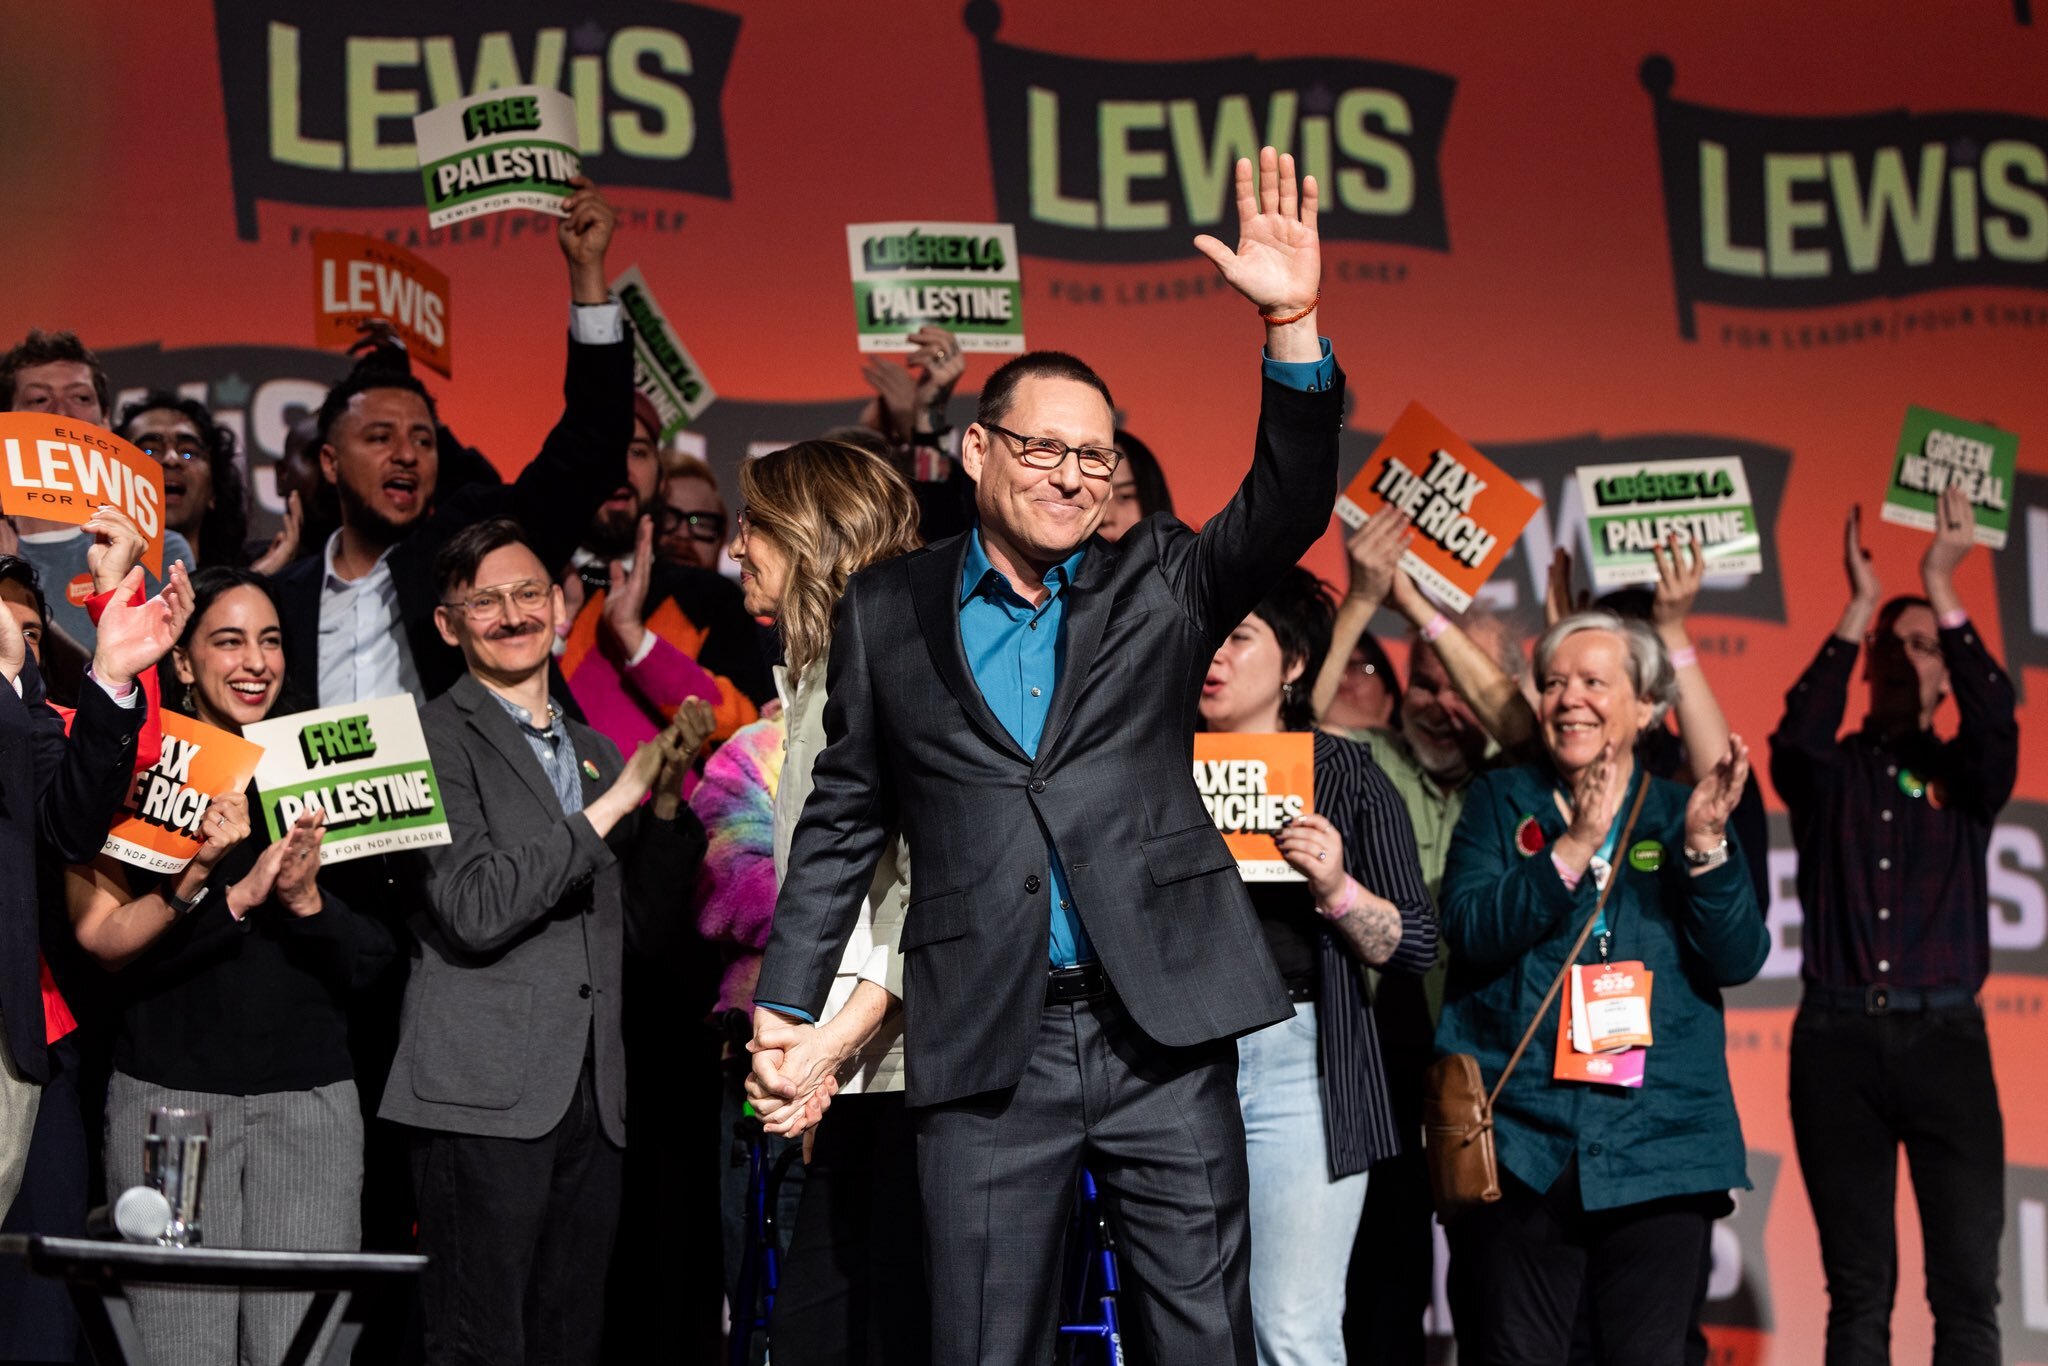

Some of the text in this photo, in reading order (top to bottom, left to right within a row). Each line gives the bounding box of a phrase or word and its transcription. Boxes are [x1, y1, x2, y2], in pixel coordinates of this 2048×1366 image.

[465, 95, 541, 141] FREE
[437, 205, 478, 223] LEWIS
[483, 197, 512, 210] FOR
[865, 227, 1006, 270] LIBÉREZ LA
[322, 258, 446, 348] LEWIS
[869, 286, 1013, 323] PALESTINE
[54, 427, 121, 456] ELECT
[1924, 429, 1995, 473] GREEN
[4, 438, 159, 539] LEWIS
[27, 491, 73, 505] FOR
[1423, 448, 1488, 514] TAX
[1596, 468, 1734, 506] LIBÉREZ LA
[1900, 453, 2007, 511] NEW DEAL
[1373, 456, 1433, 518] THE
[1416, 493, 1498, 569] RICH
[1604, 510, 1746, 553] PALESTINE
[150, 732, 202, 784] AX
[300, 714, 377, 767] FREE
[1193, 760, 1268, 794] AXER
[277, 770, 436, 830] PALESTINE
[105, 841, 121, 852] OR
[124, 848, 147, 861] NDP
[335, 844, 362, 856] FOR
[367, 837, 393, 849] NDP
[397, 830, 443, 845] LEADER
